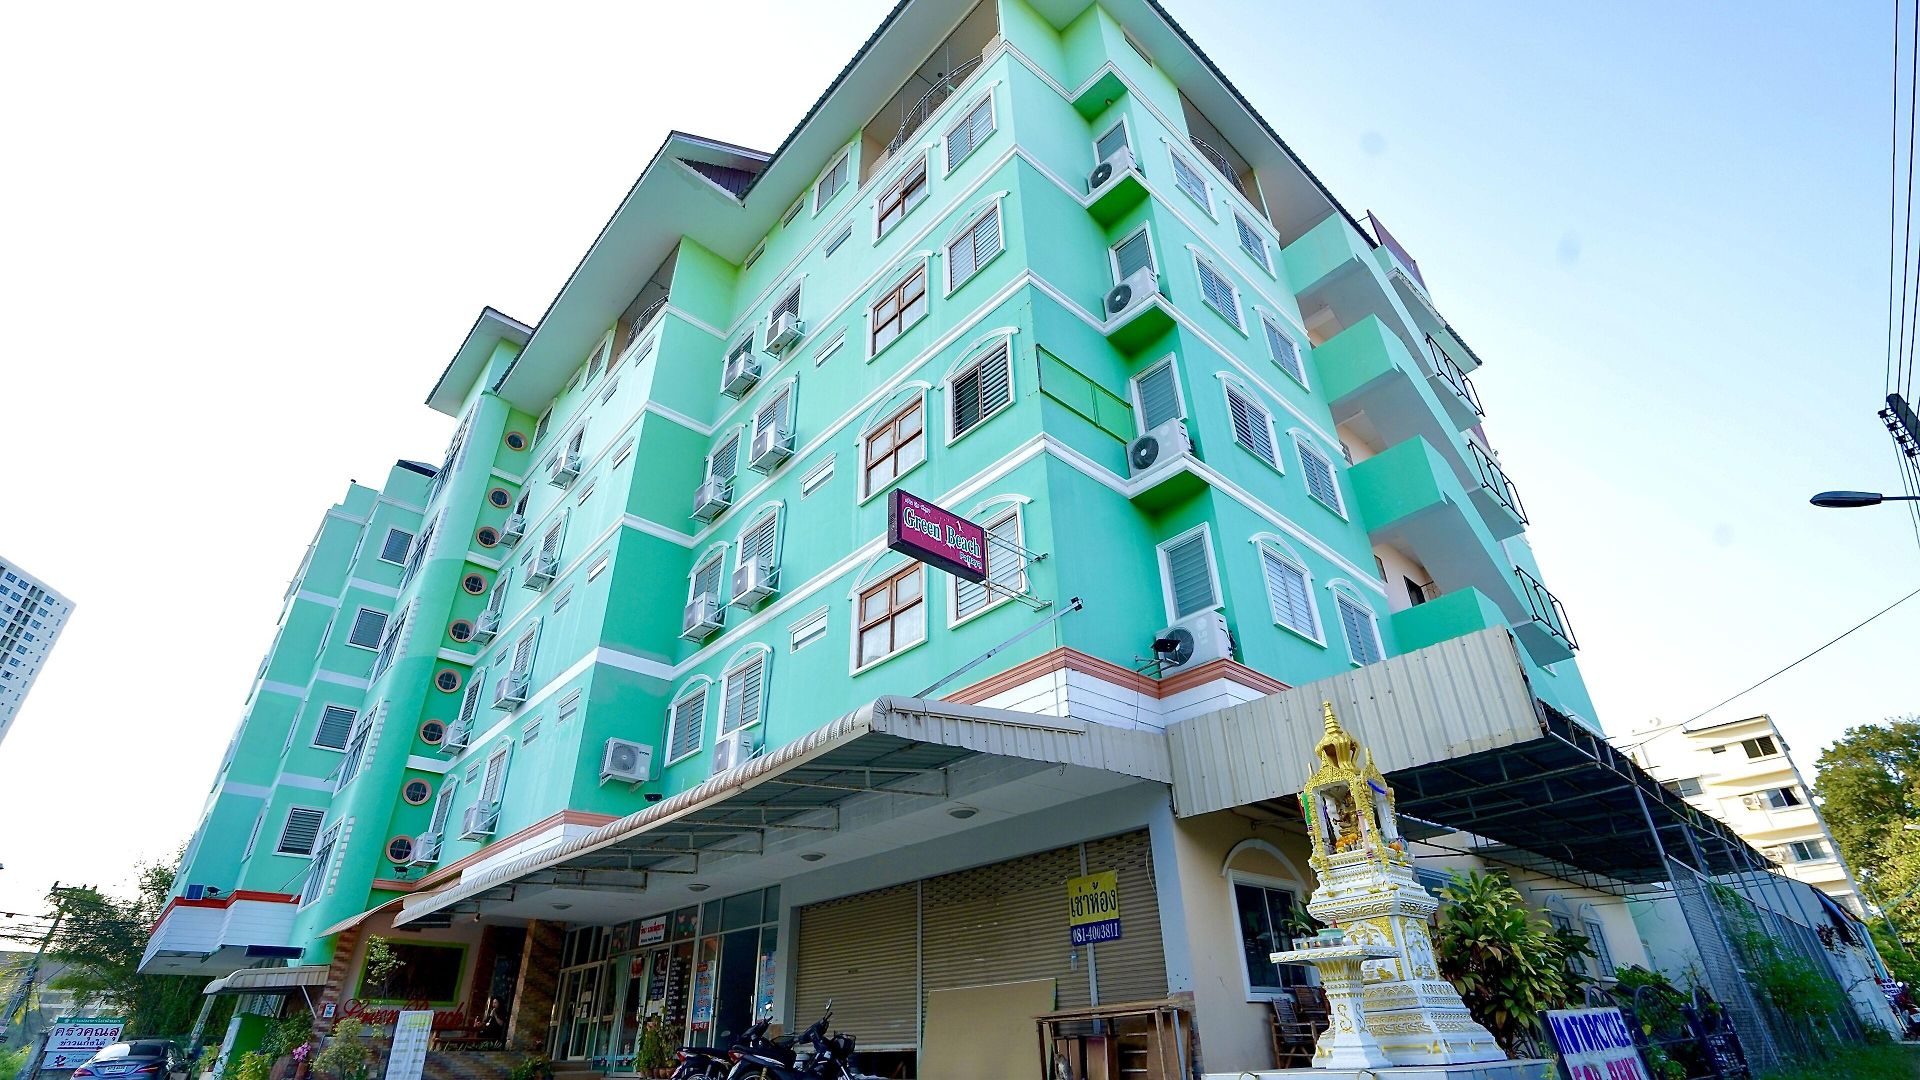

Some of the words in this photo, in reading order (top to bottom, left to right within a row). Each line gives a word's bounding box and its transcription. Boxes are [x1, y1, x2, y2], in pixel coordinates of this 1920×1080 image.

[903, 507, 941, 541] Green
[946, 524, 981, 558] Beach
[1070, 882, 1117, 917] เช่าห้อง
[55, 1023, 121, 1041] ครัวคุณสุ
[1550, 1012, 1632, 1054] MOTORCYCLE
